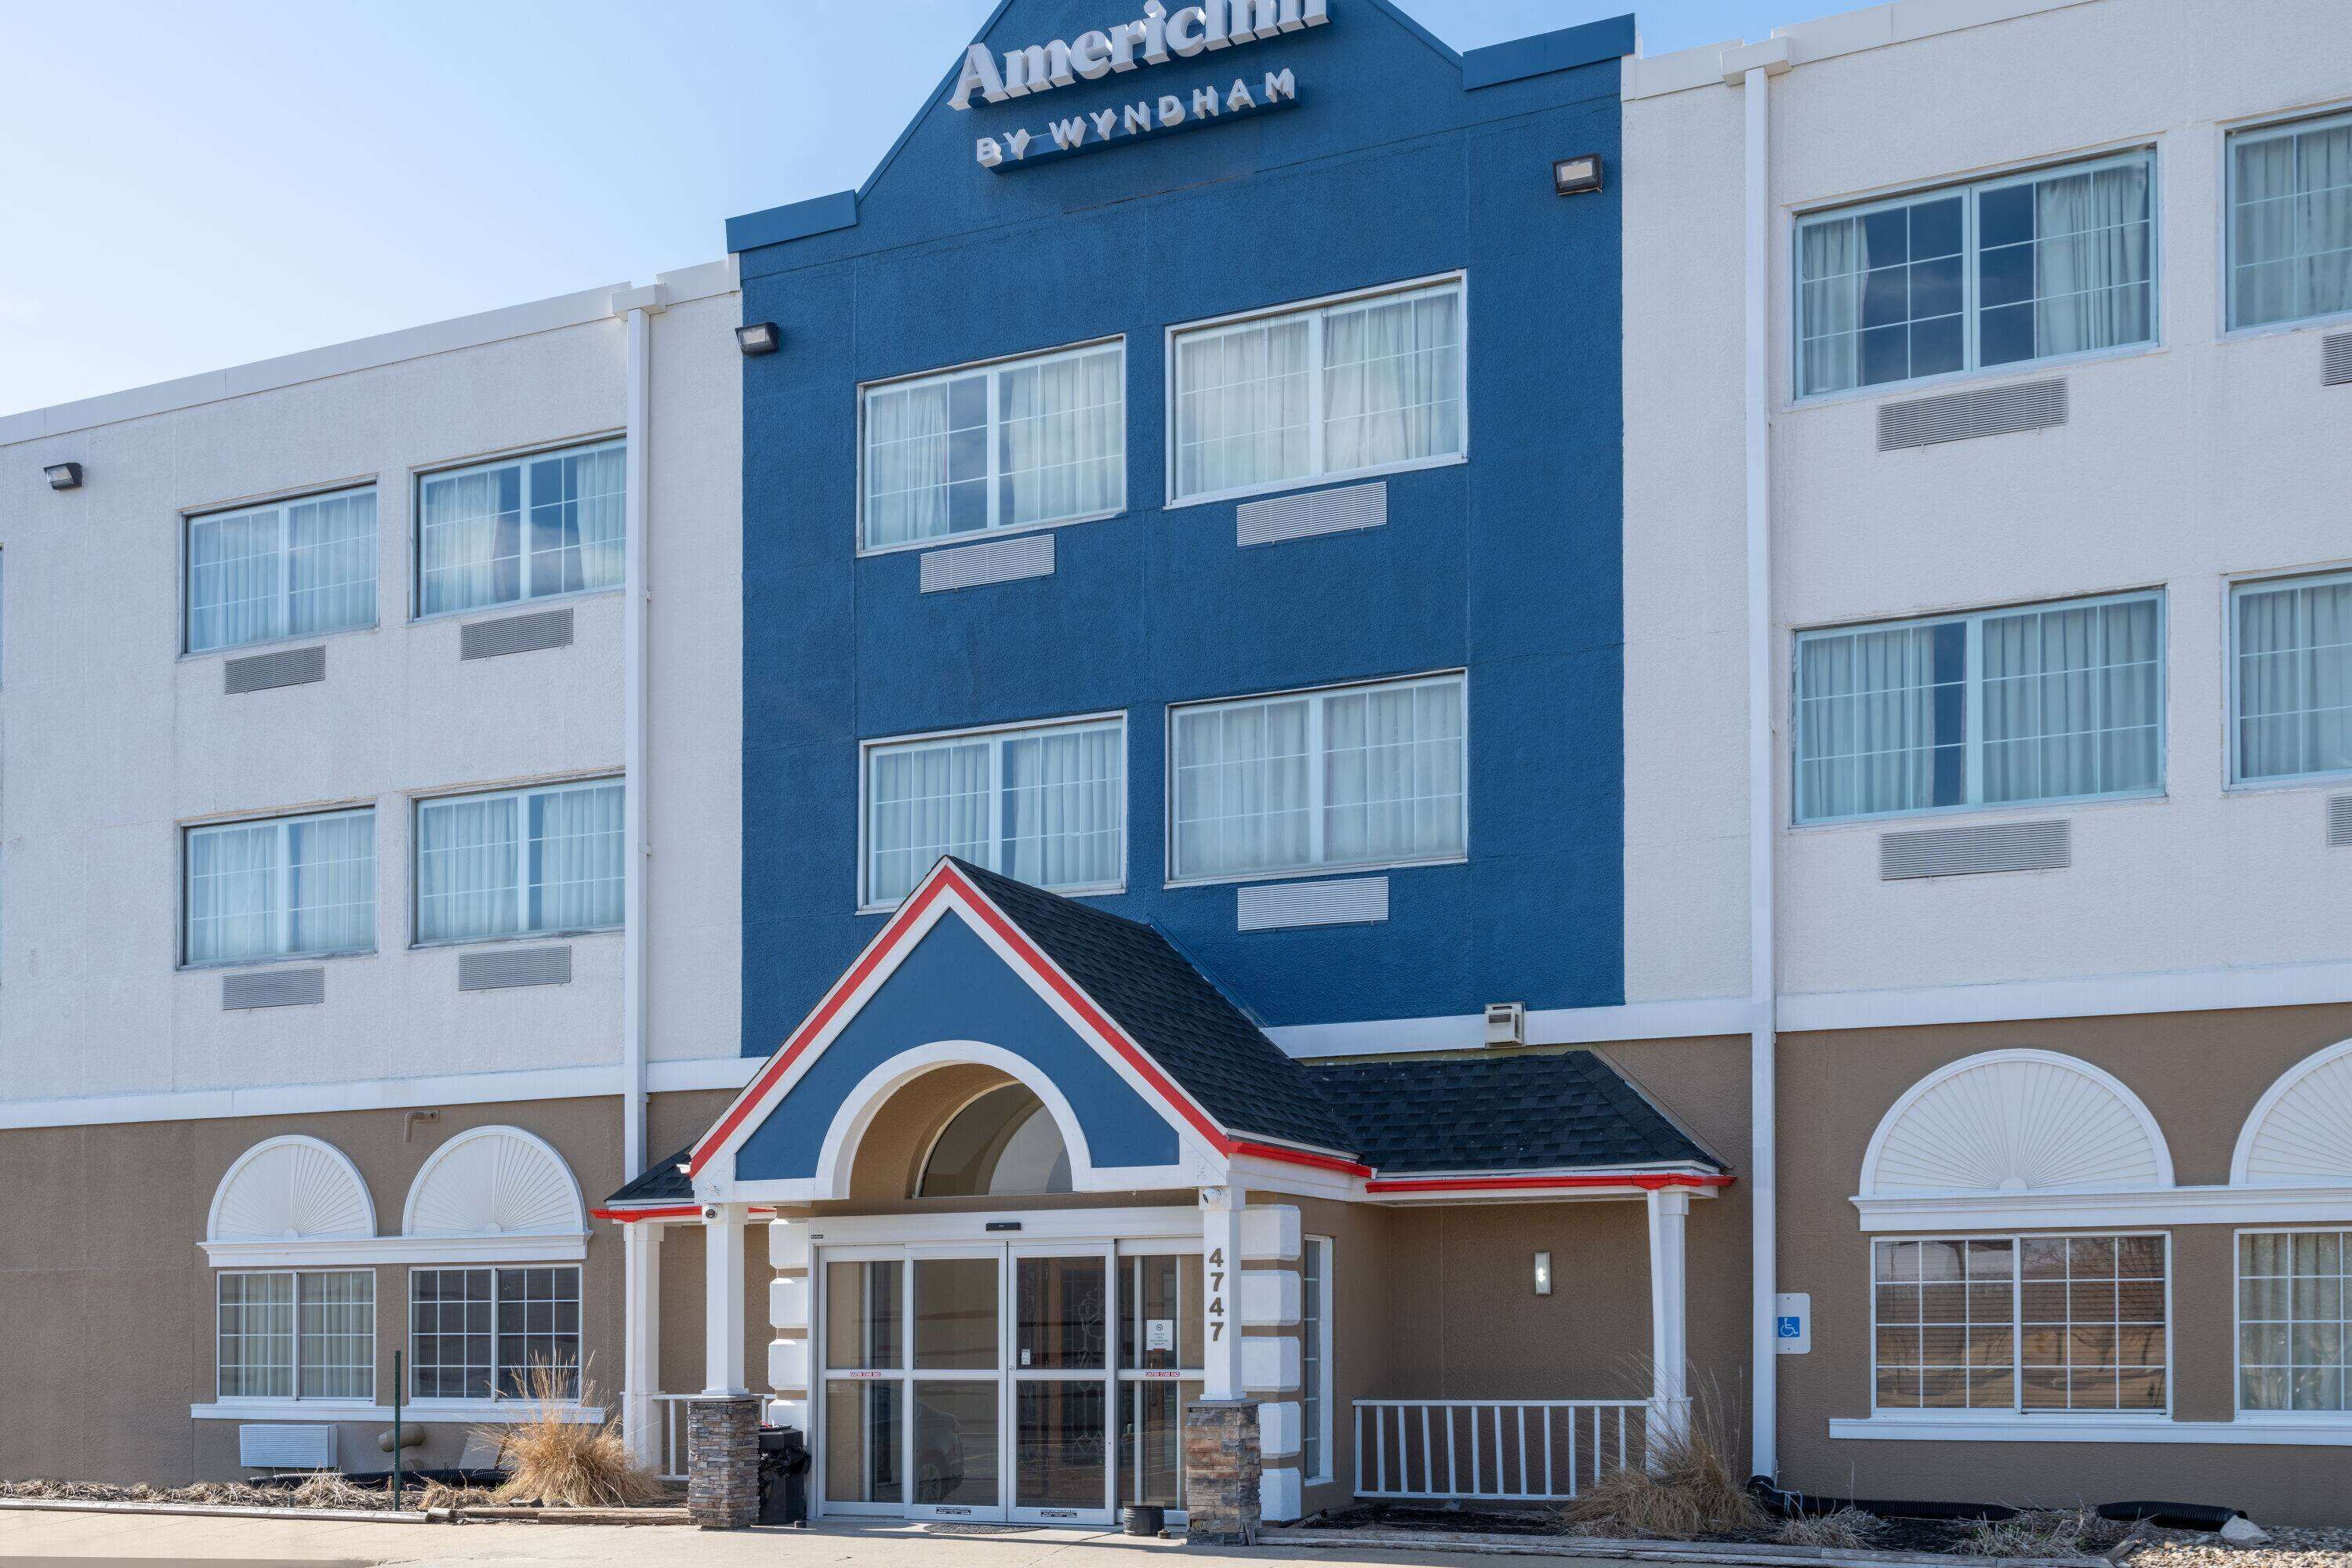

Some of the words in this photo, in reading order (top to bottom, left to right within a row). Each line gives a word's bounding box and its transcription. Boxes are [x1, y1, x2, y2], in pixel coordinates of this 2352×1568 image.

[977, 129, 1031, 168] BY
[1049, 68, 1295, 151] WYNDHAM
[1208, 1247, 1225, 1342] 4747
